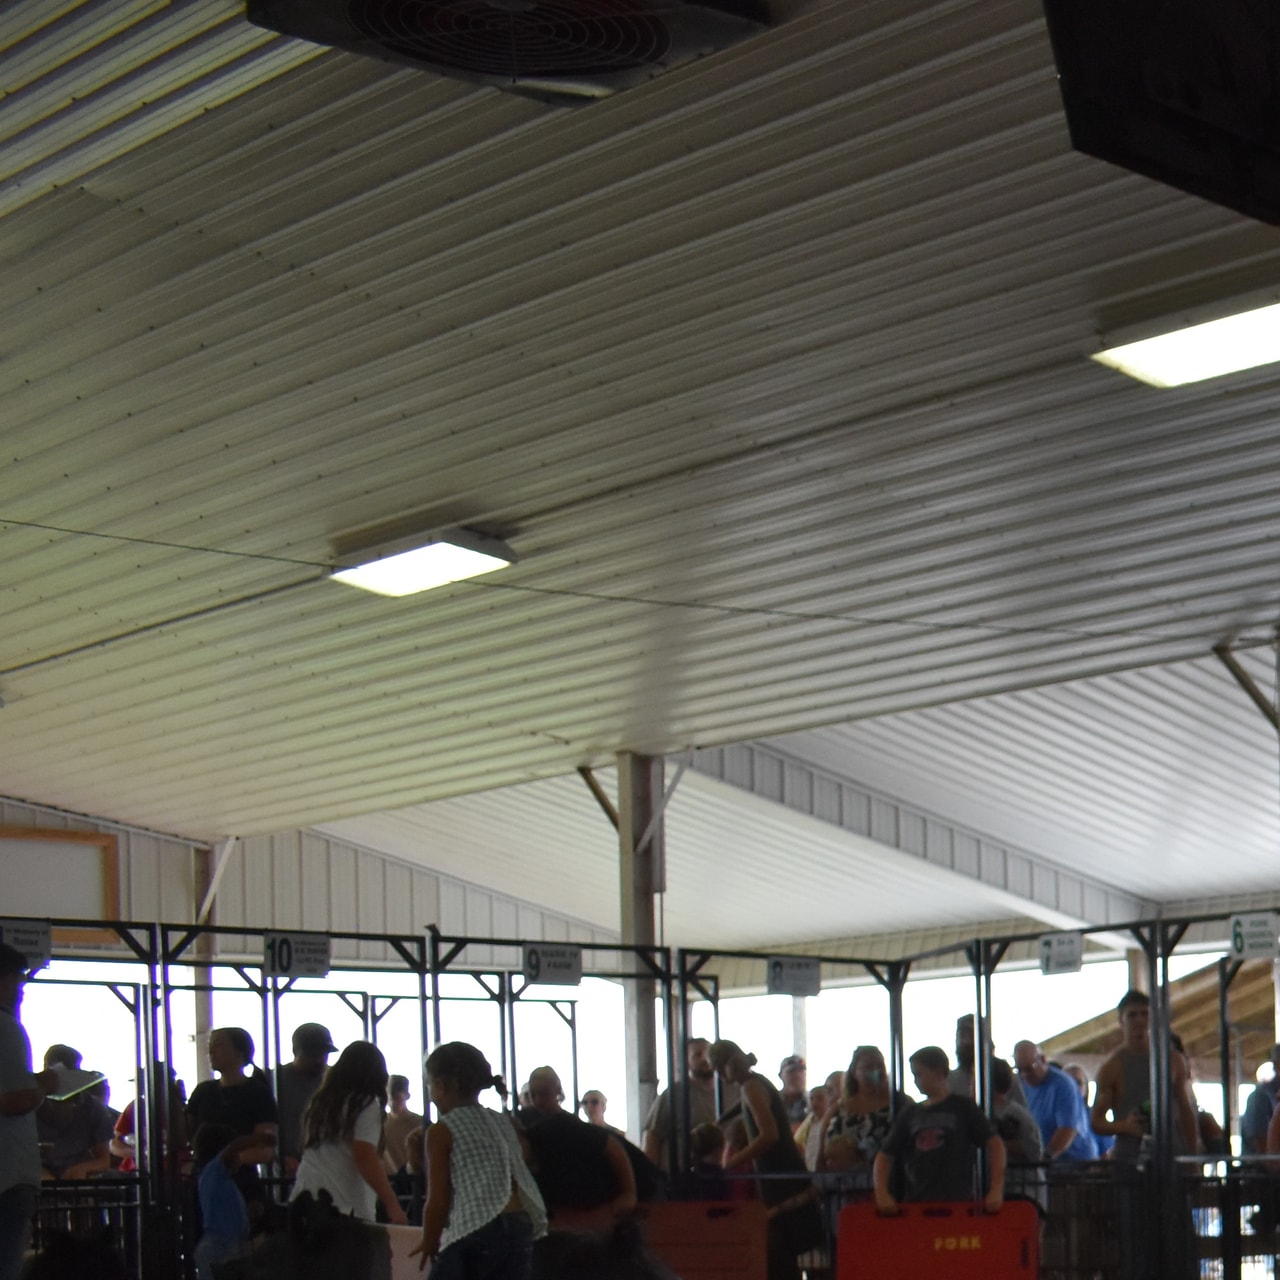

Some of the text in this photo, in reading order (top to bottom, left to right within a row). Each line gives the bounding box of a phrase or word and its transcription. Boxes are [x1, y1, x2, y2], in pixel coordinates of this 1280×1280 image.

[1232, 919, 1244, 954] 6
[266, 937, 292, 973] 10
[527, 948, 540, 981] 9
